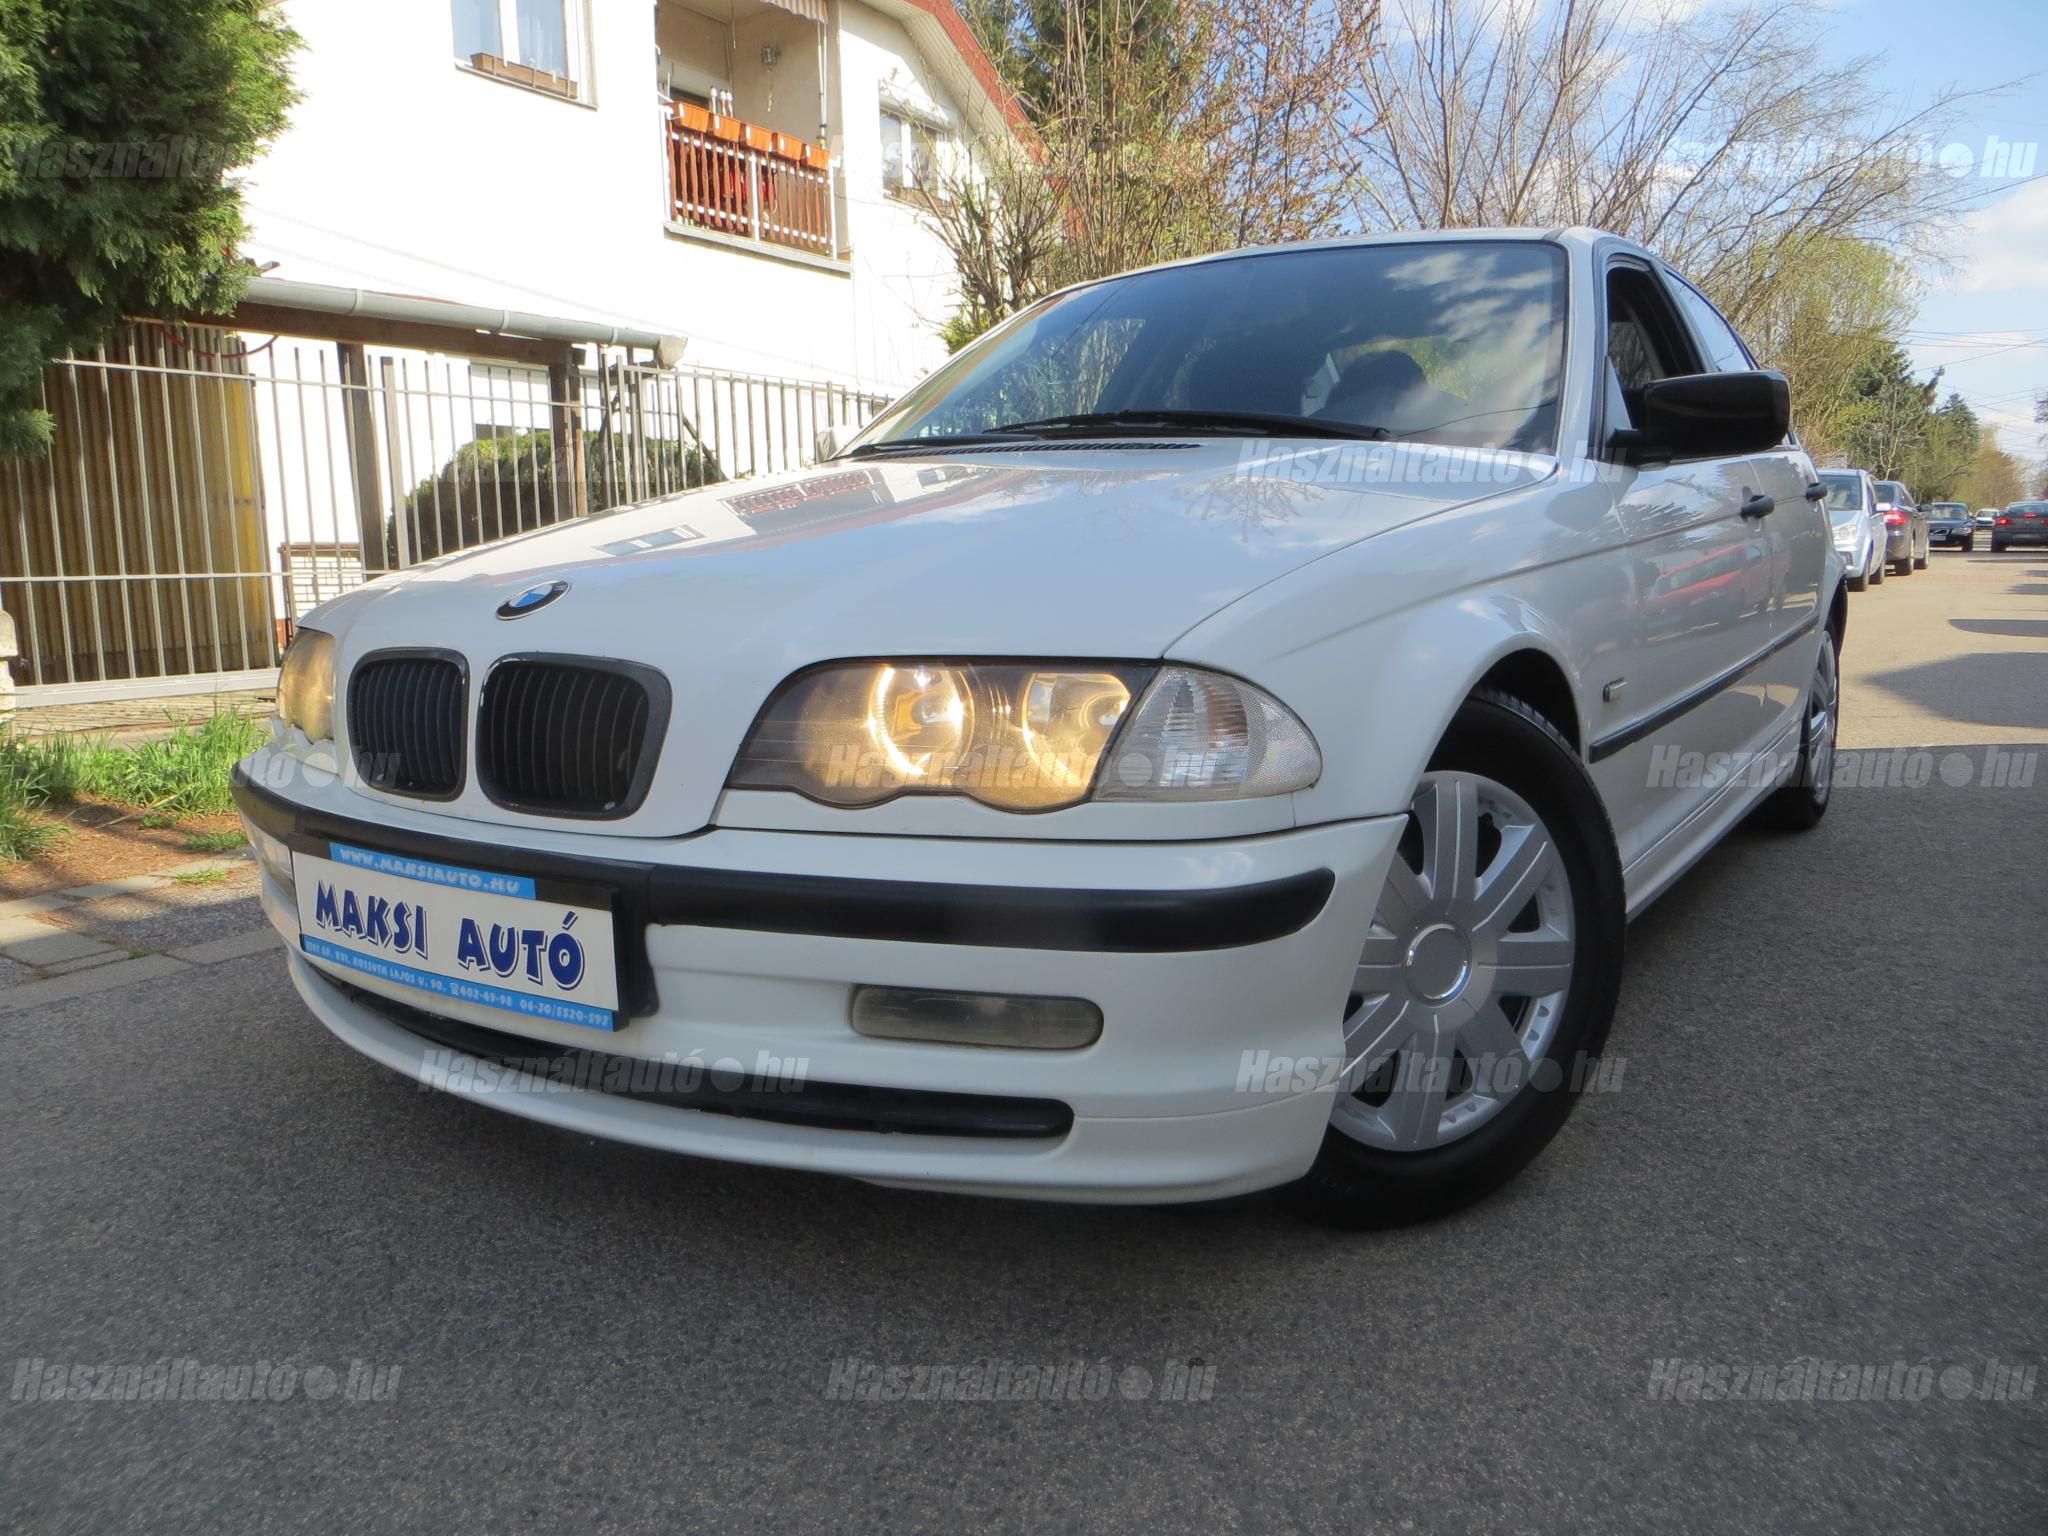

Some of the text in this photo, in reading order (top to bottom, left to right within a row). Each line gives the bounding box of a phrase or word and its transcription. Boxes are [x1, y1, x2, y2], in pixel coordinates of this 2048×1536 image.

[340, 848, 520, 895] WWW.MAKSIAUTO.HU
[316, 880, 585, 991] MAKSI AUTÓ
